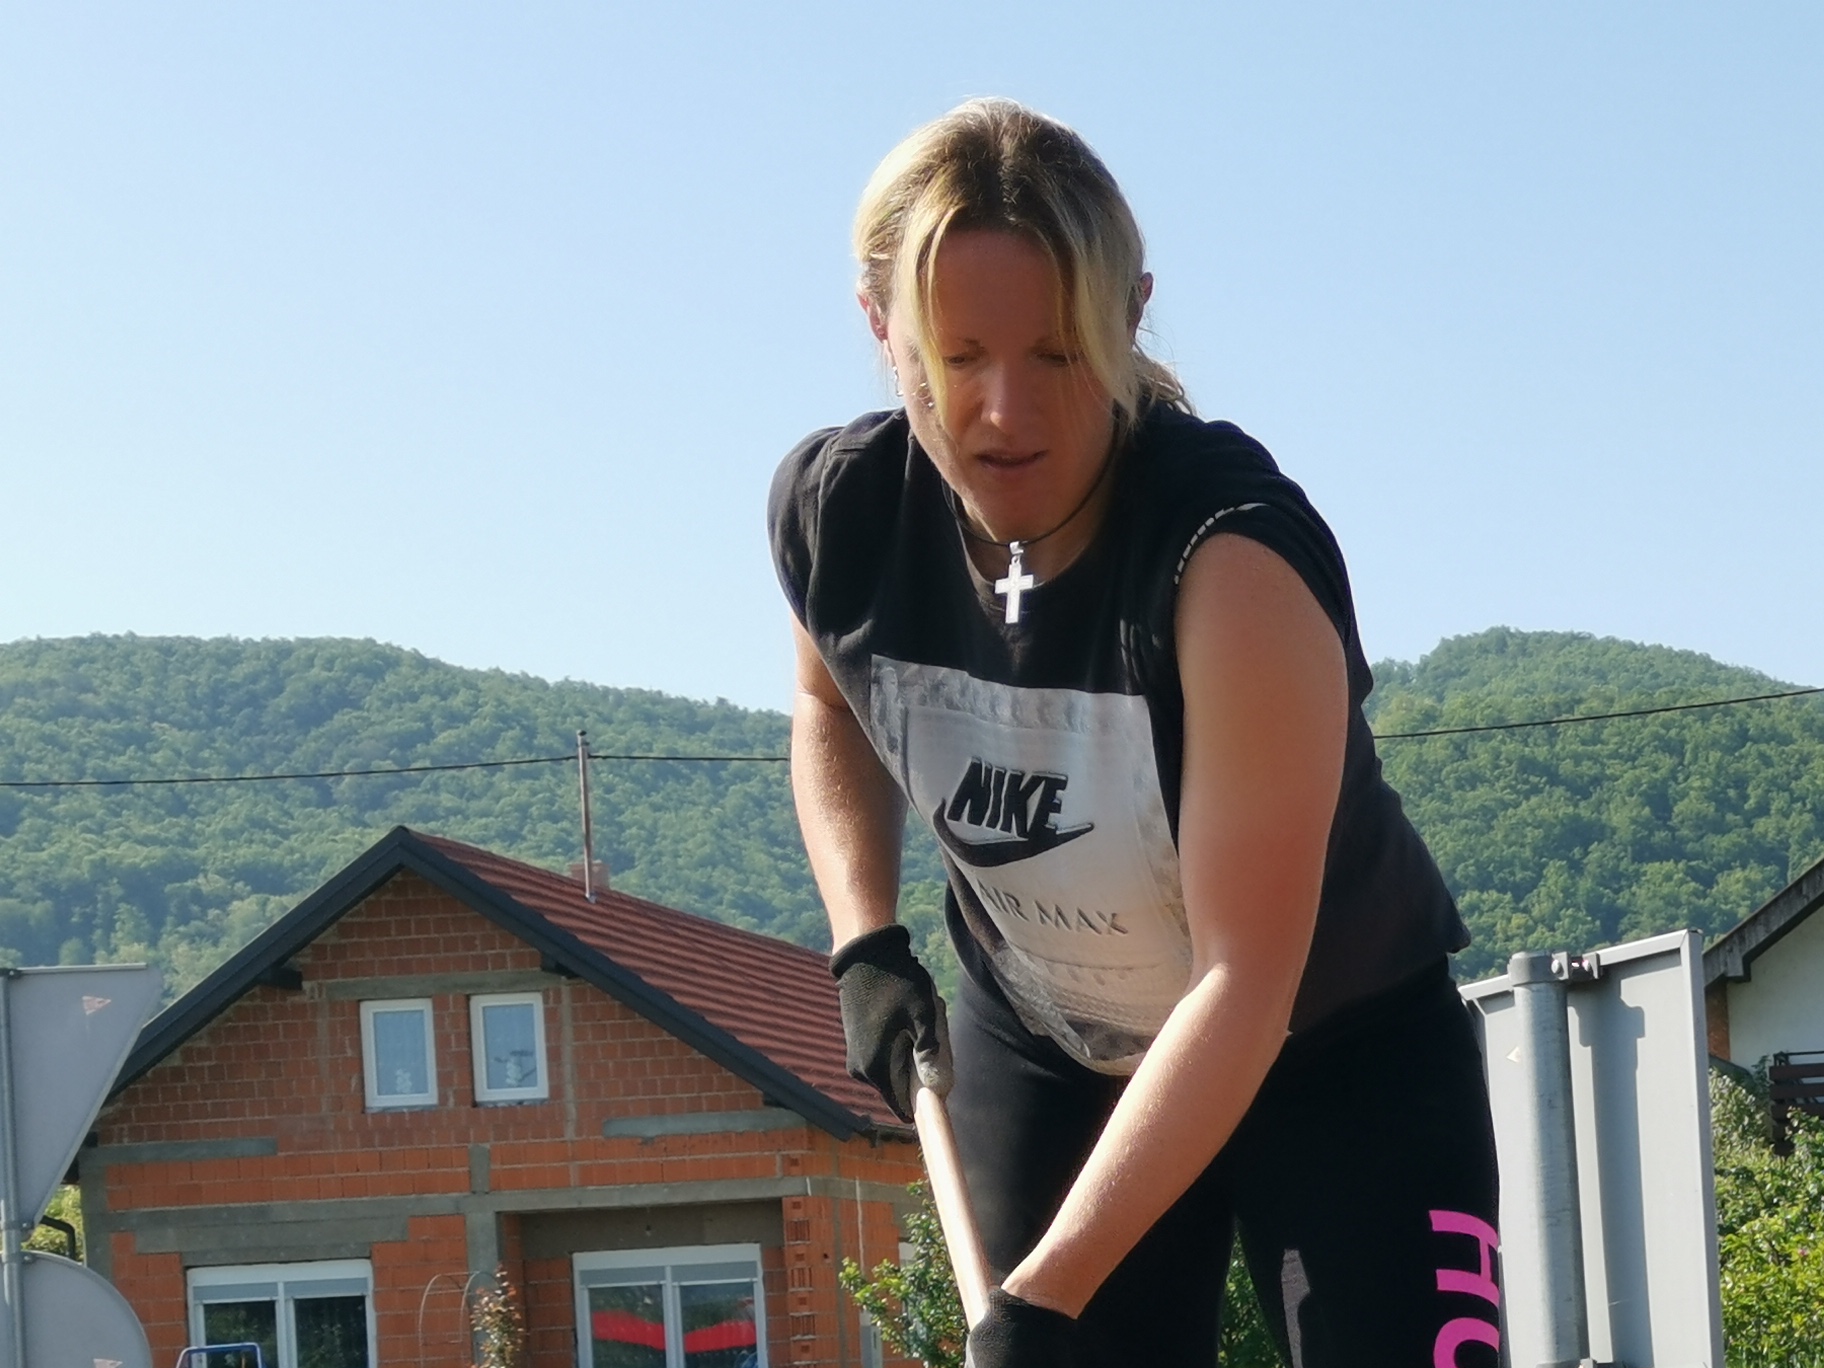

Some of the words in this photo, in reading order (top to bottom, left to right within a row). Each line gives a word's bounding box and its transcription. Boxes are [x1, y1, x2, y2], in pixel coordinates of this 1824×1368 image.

[947, 757, 1068, 838] NIKE
[976, 878, 1031, 922] AIR
[1033, 899, 1129, 935] MAX
